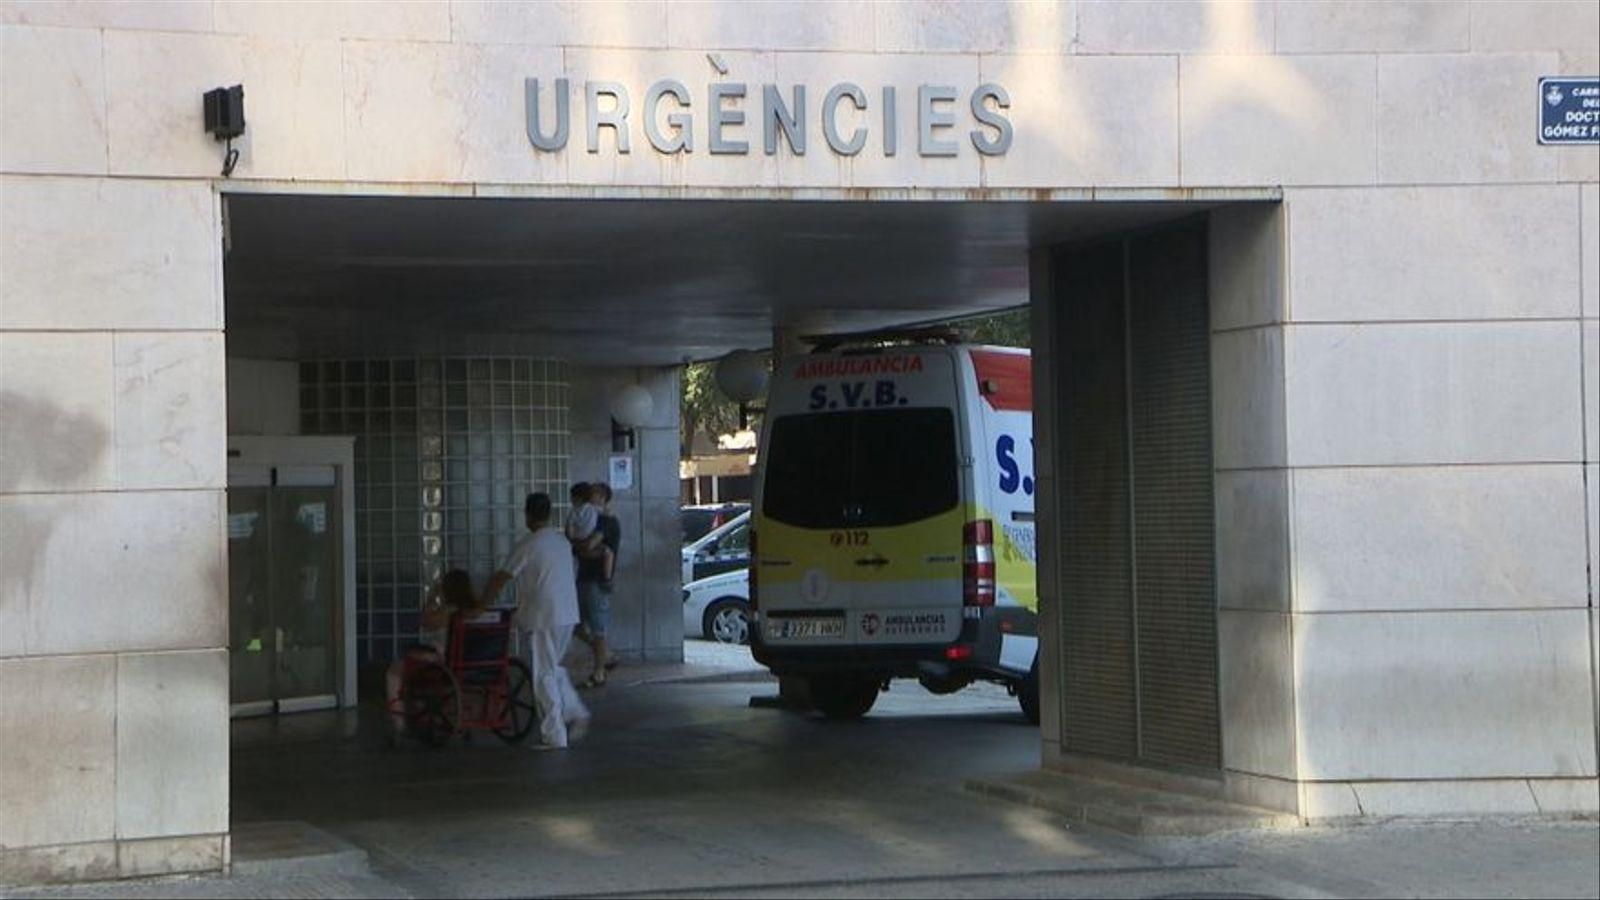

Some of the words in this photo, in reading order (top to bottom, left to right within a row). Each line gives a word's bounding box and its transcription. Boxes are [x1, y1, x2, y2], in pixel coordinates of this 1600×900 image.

[524, 54, 1014, 157] URGÈNCIES
[1566, 111, 1599, 122] DOCT
[1544, 123, 1588, 137] GÓMEZ
[793, 354, 924, 379] AMBULANCIA
[810, 380, 909, 409] S.V.B.
[996, 434, 1035, 495] S.
[847, 531, 869, 546] 112
[885, 613, 946, 625] AMBULANCIAS
